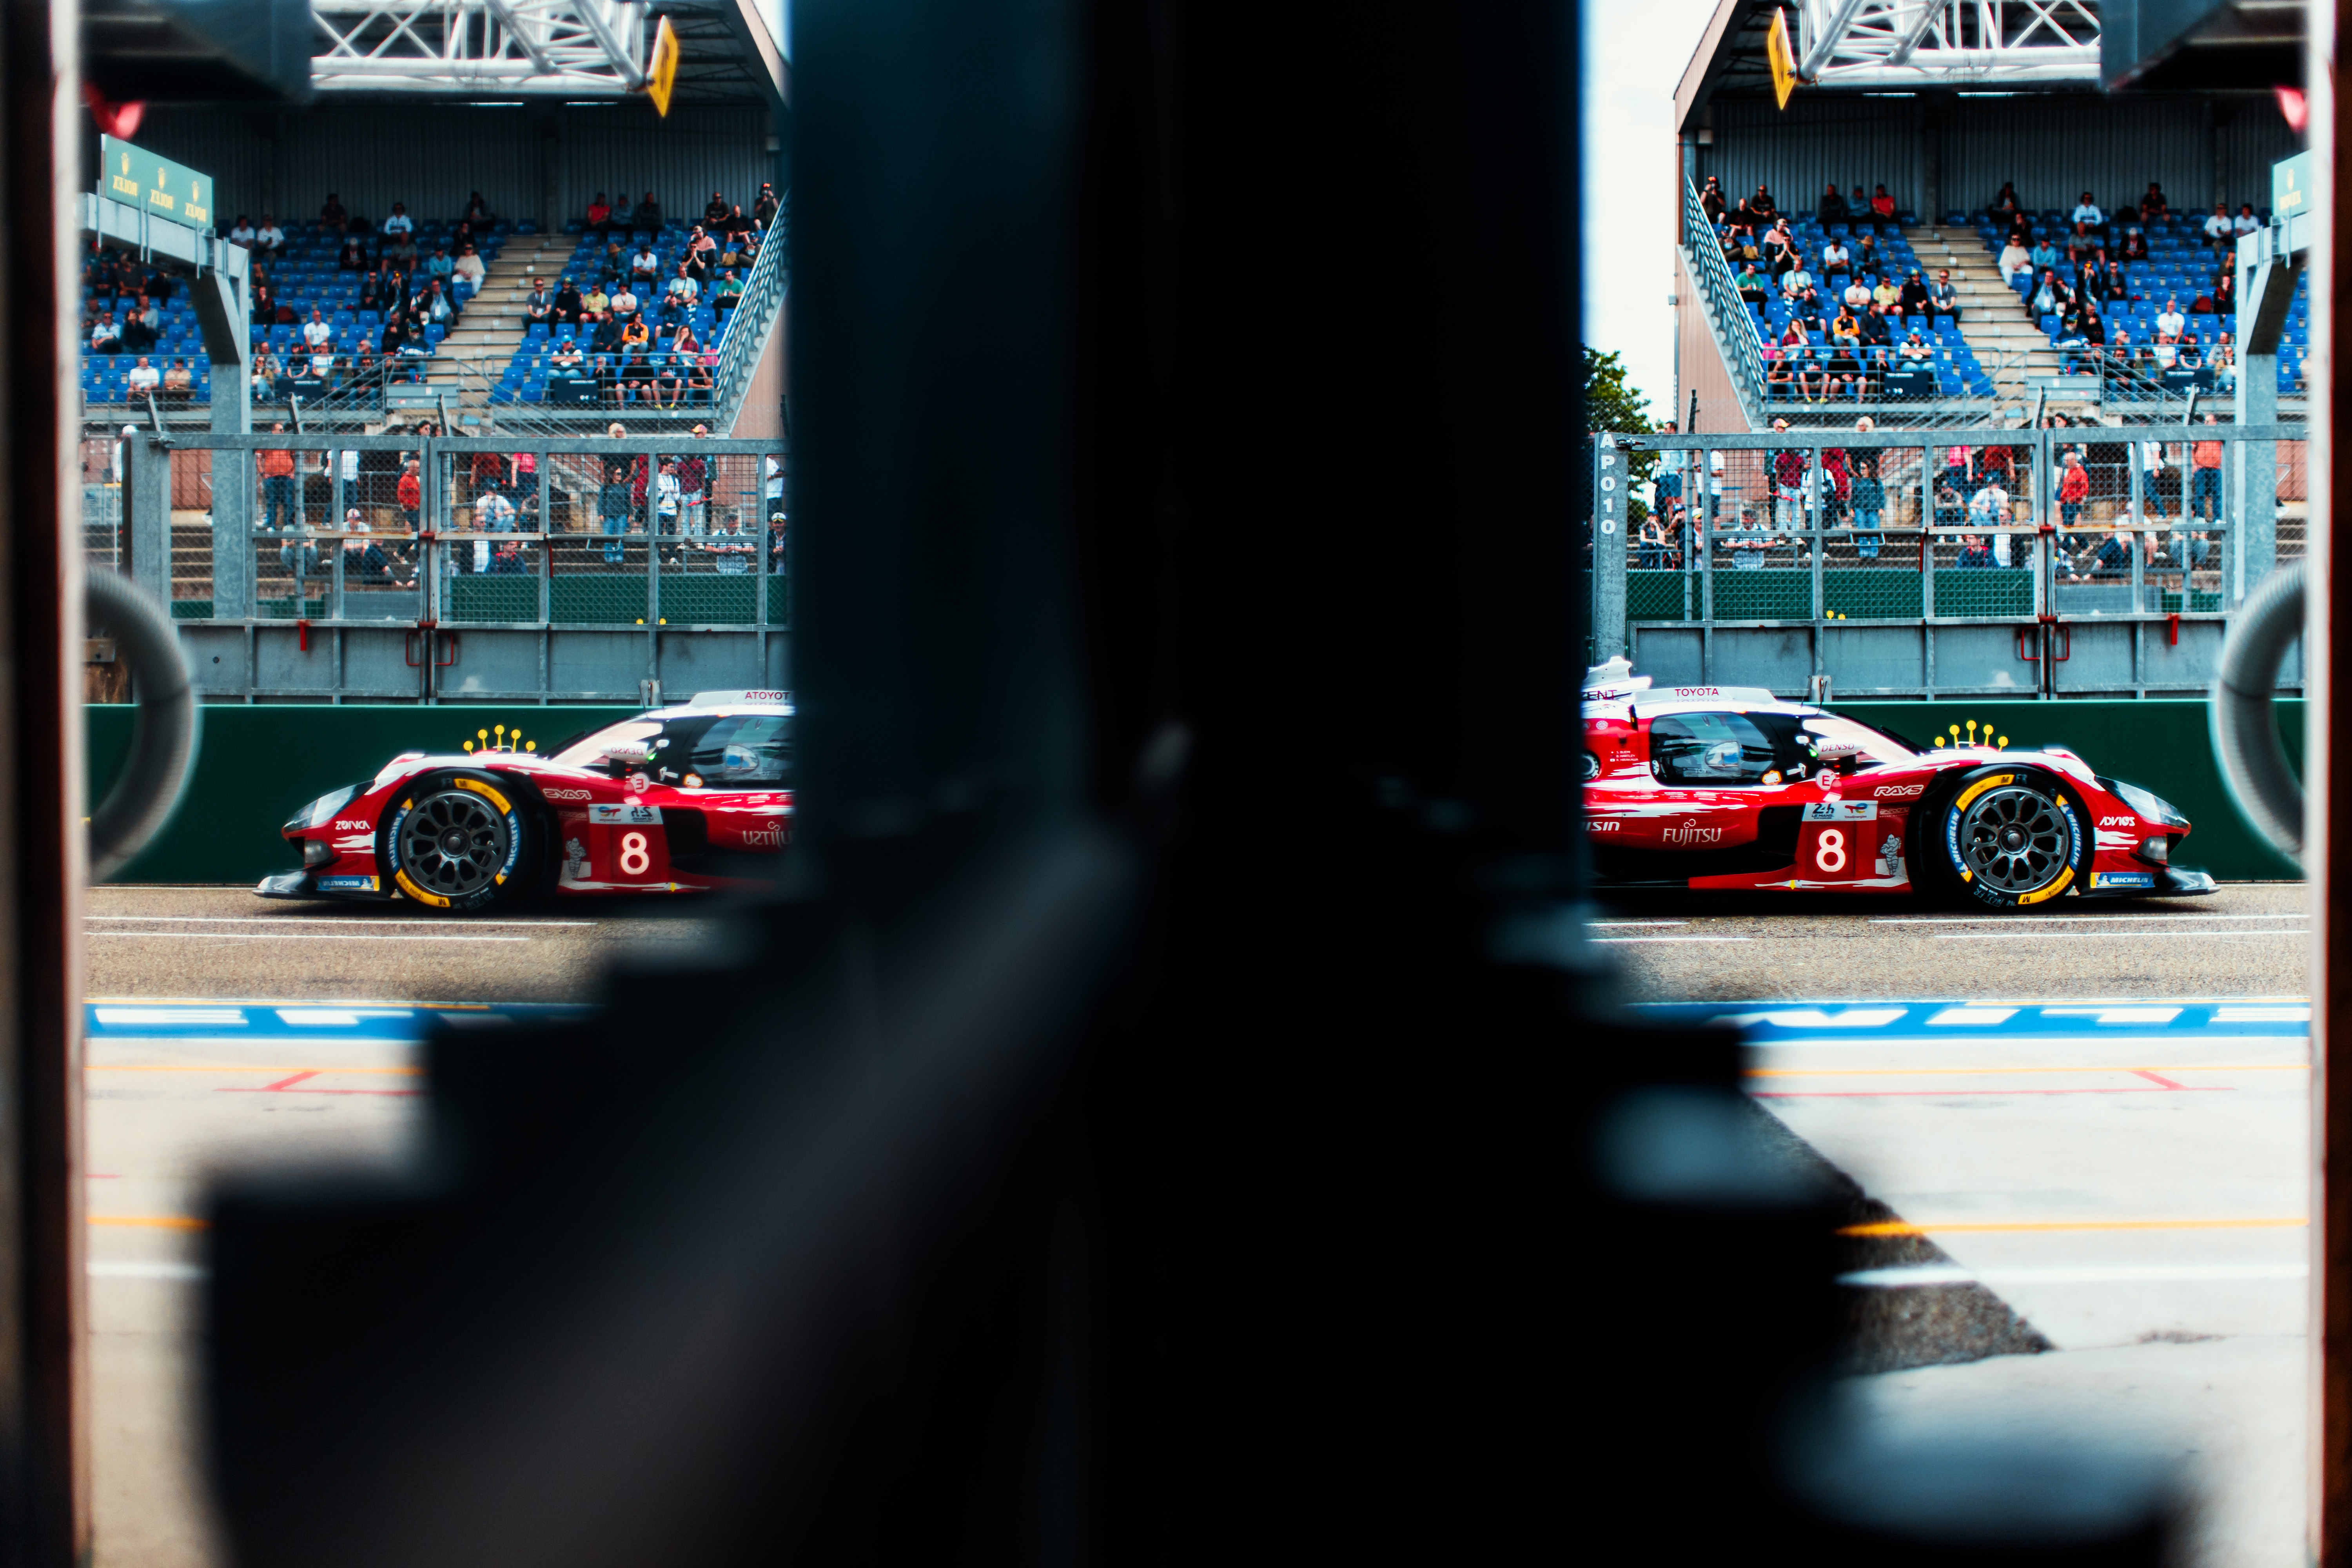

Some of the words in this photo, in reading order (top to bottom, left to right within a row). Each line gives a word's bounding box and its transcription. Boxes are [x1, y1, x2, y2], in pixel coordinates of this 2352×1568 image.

[1674, 688, 1719, 697] TOYOTA
[1821, 743, 1855, 752] DENSO
[1874, 784, 1924, 796] RAYS
[1584, 822, 1620, 831] ISIN
[1662, 828, 1722, 846] FUJITSU
[1949, 812, 1962, 863] MICHELIN
[2068, 814, 2081, 865] MICHELIN
[1816, 829, 1846, 872] 8
[2045, 884, 2060, 897] SPORT
